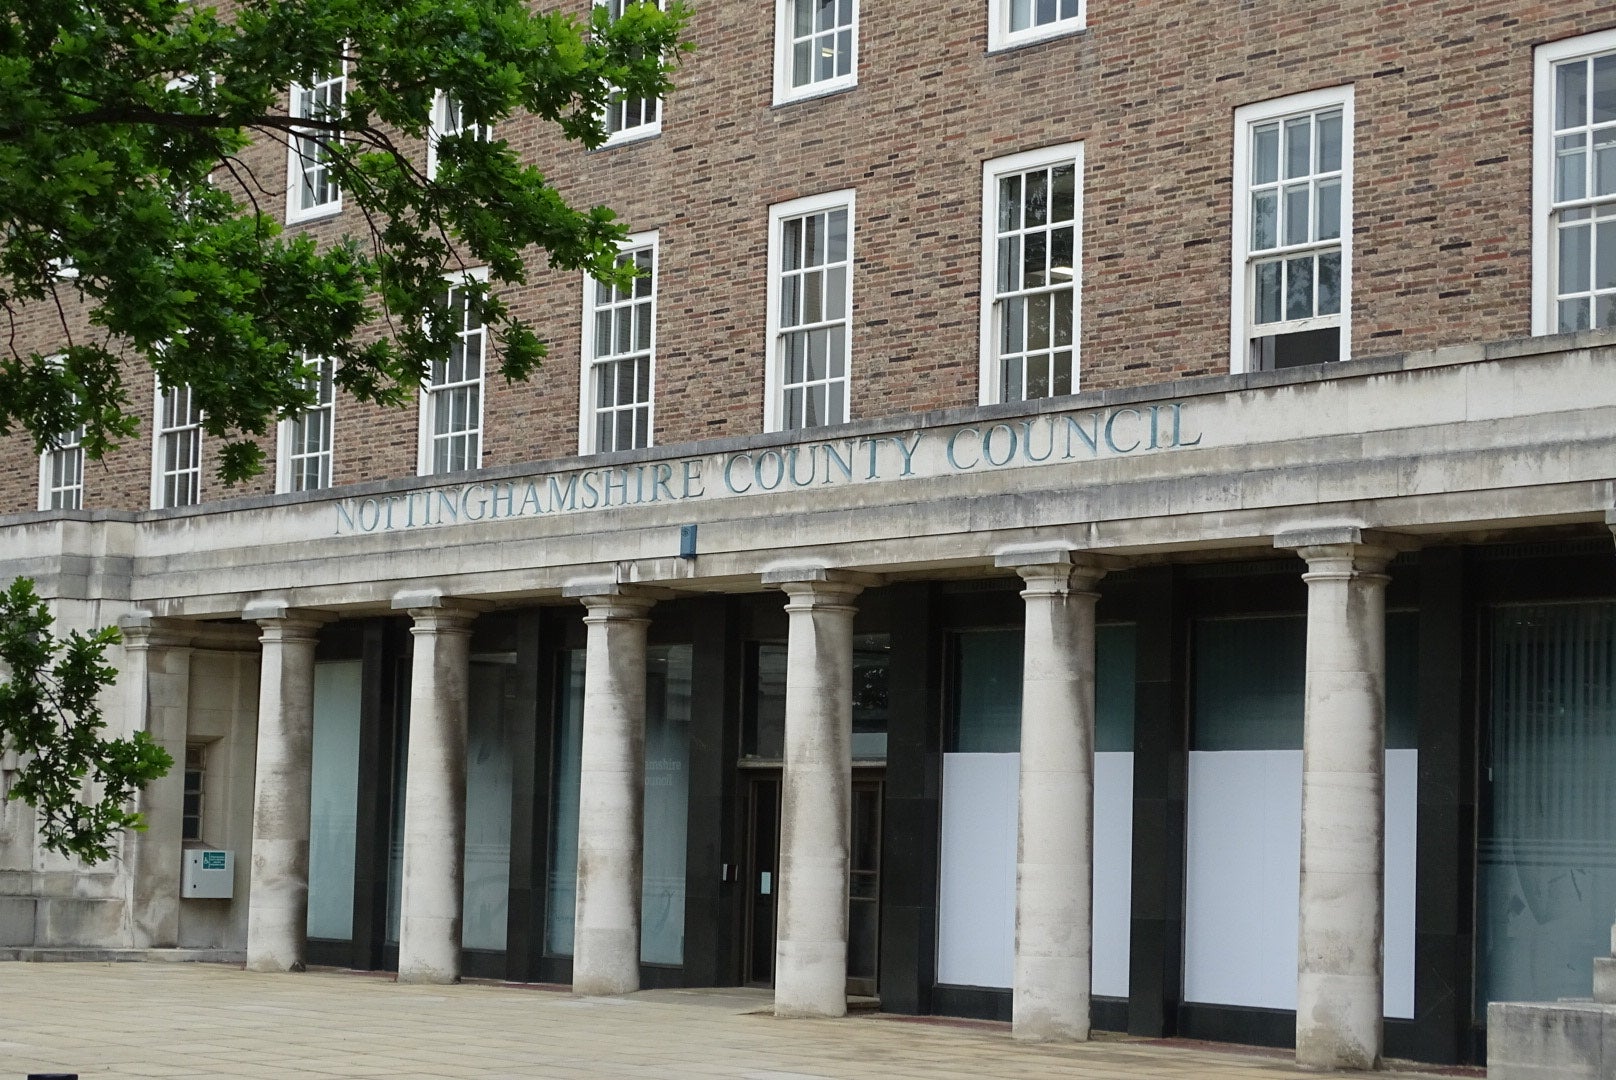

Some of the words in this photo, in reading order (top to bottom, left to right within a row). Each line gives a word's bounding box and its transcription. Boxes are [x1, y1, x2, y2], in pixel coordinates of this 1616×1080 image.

[335, 459, 705, 534] NOTTINGHAMSHIRE
[724, 433, 926, 494] COUNTY
[946, 402, 1203, 470] COUNCIL
